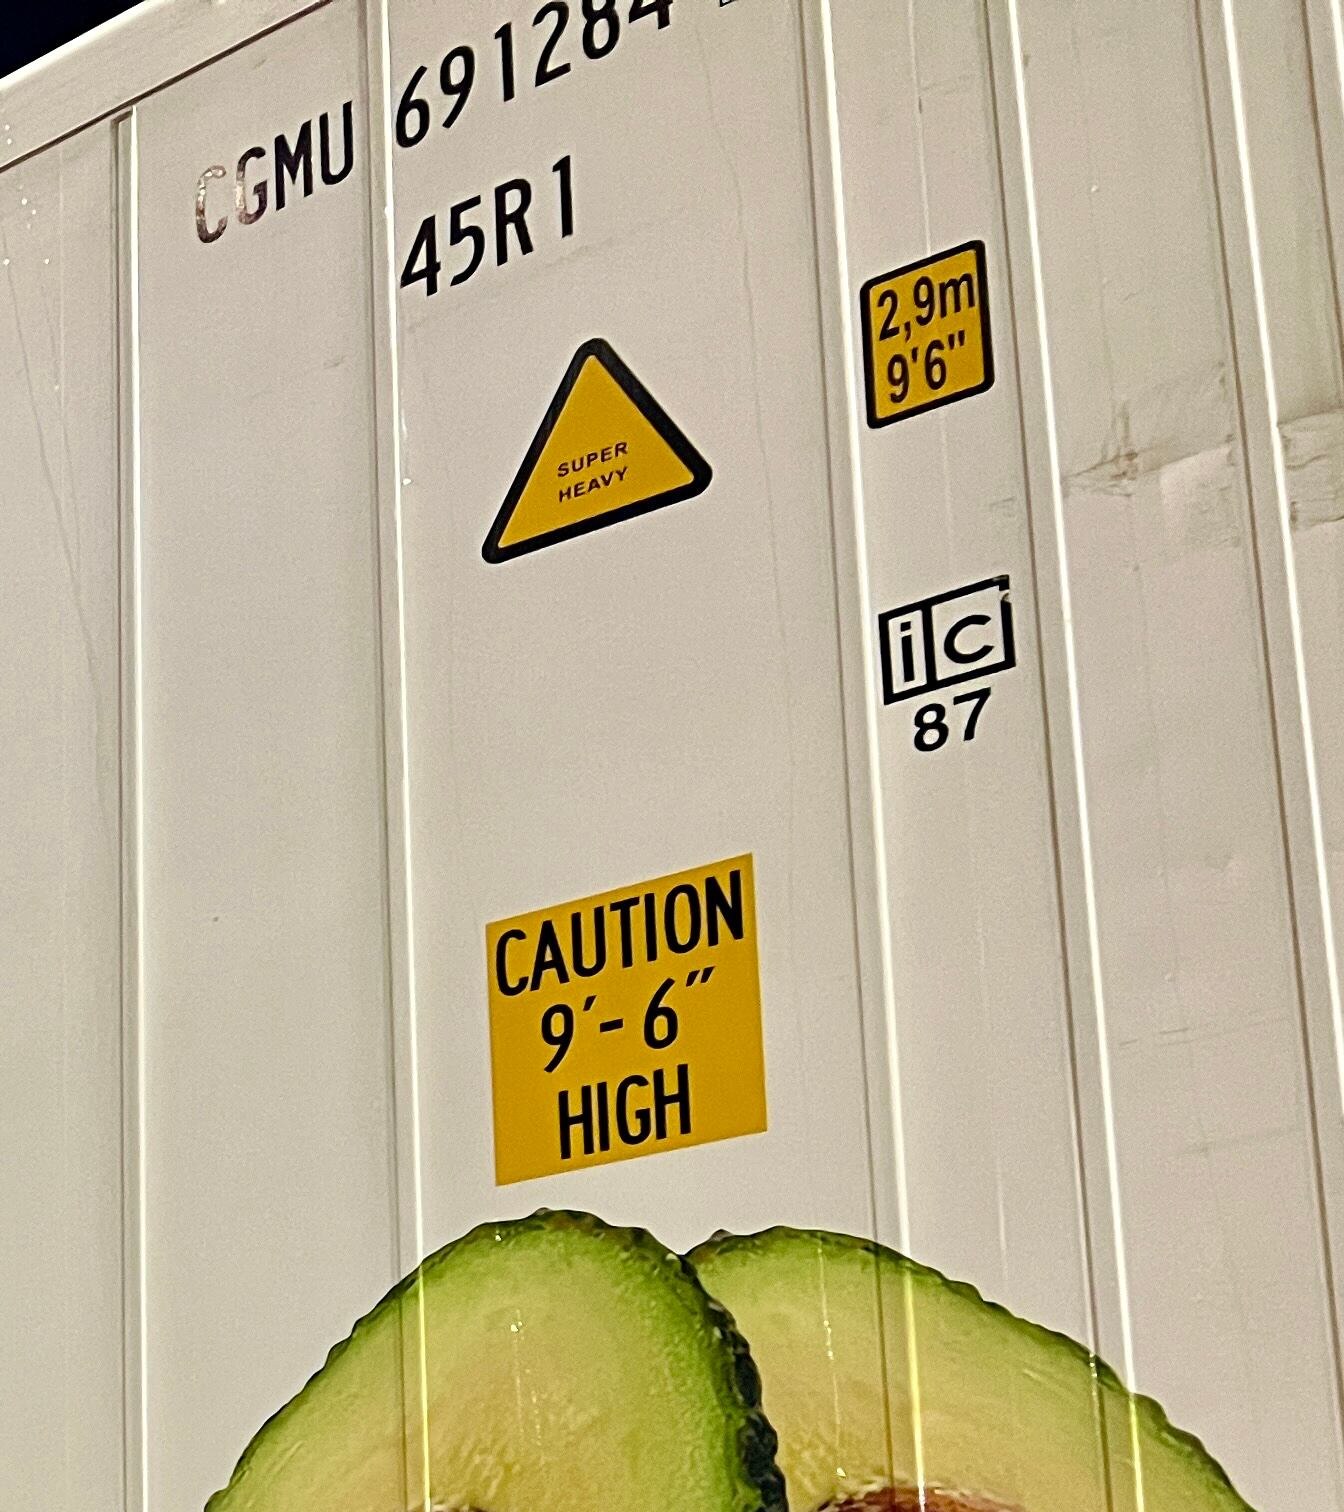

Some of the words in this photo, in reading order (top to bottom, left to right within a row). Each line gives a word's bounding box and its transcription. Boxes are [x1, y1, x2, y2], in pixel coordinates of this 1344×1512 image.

[195, 100, 354, 244] CGMU
[400, 155, 574, 297] 45R1
[877, 272, 976, 344] 2,9m
[887, 330, 966, 404] 9'6"
[557, 441, 628, 478] SUPER
[558, 466, 628, 503] HEAVY
[913, 686, 992, 752] 87
[495, 869, 744, 997] CAUTION
[557, 1063, 692, 1160] HIGH
